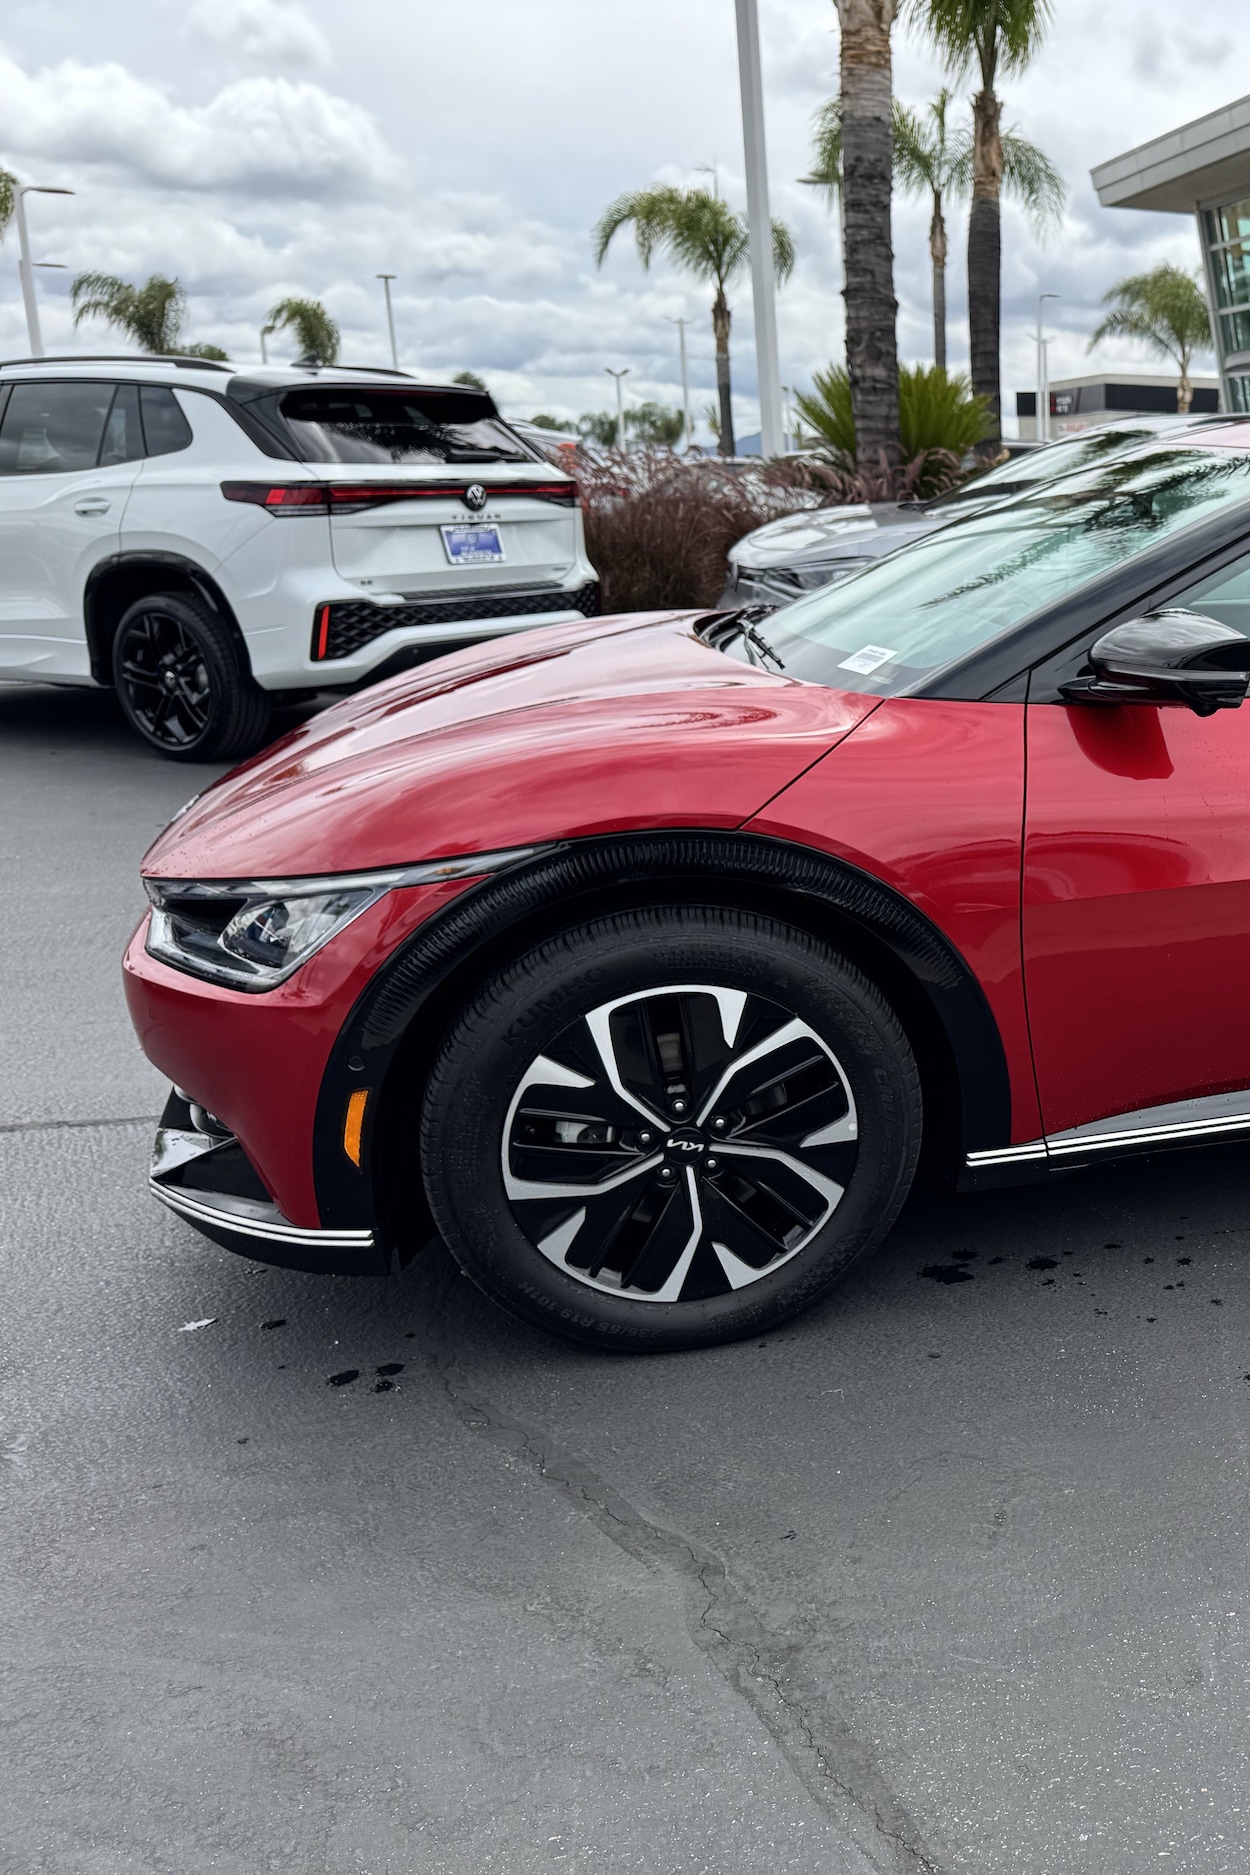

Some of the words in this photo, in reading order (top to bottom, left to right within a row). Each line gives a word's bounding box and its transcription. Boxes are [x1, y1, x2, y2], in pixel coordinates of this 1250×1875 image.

[498, 965, 606, 1048] KUMHO
[517, 1281, 558, 1311] 101H
[559, 1307, 595, 1329] R19
